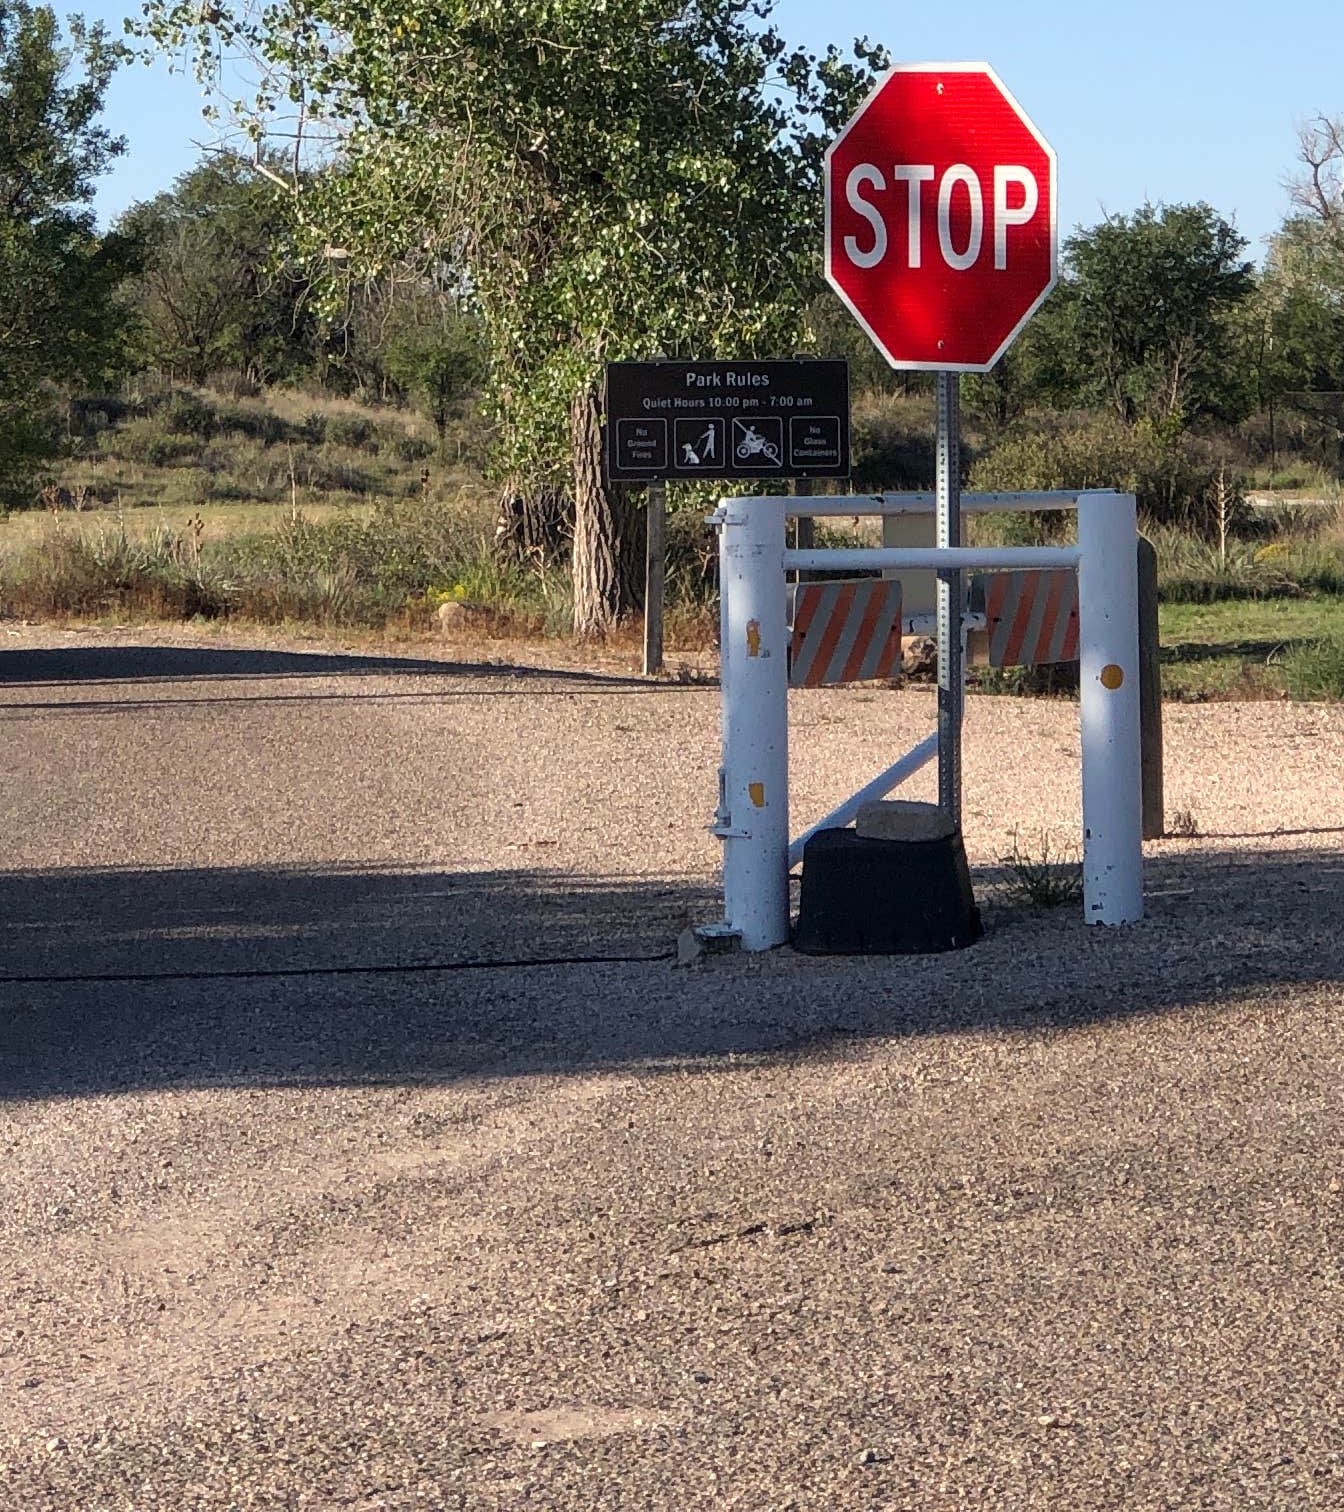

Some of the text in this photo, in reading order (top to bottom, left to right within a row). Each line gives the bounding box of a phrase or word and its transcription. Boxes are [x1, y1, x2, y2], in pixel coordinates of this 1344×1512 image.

[843, 162, 1039, 271] STOP
[686, 371, 770, 387] Park Rules
[642, 397, 672, 409] Quiet
[674, 397, 705, 408] Hours
[709, 397, 740, 407] 10:00
[743, 398, 759, 409] pm
[770, 396, 794, 407] 7:00
[797, 398, 813, 407] am
[636, 428, 648, 437] No
[809, 426, 821, 435] No
[804, 437, 827, 446] Glass
[793, 448, 838, 458] Containers
